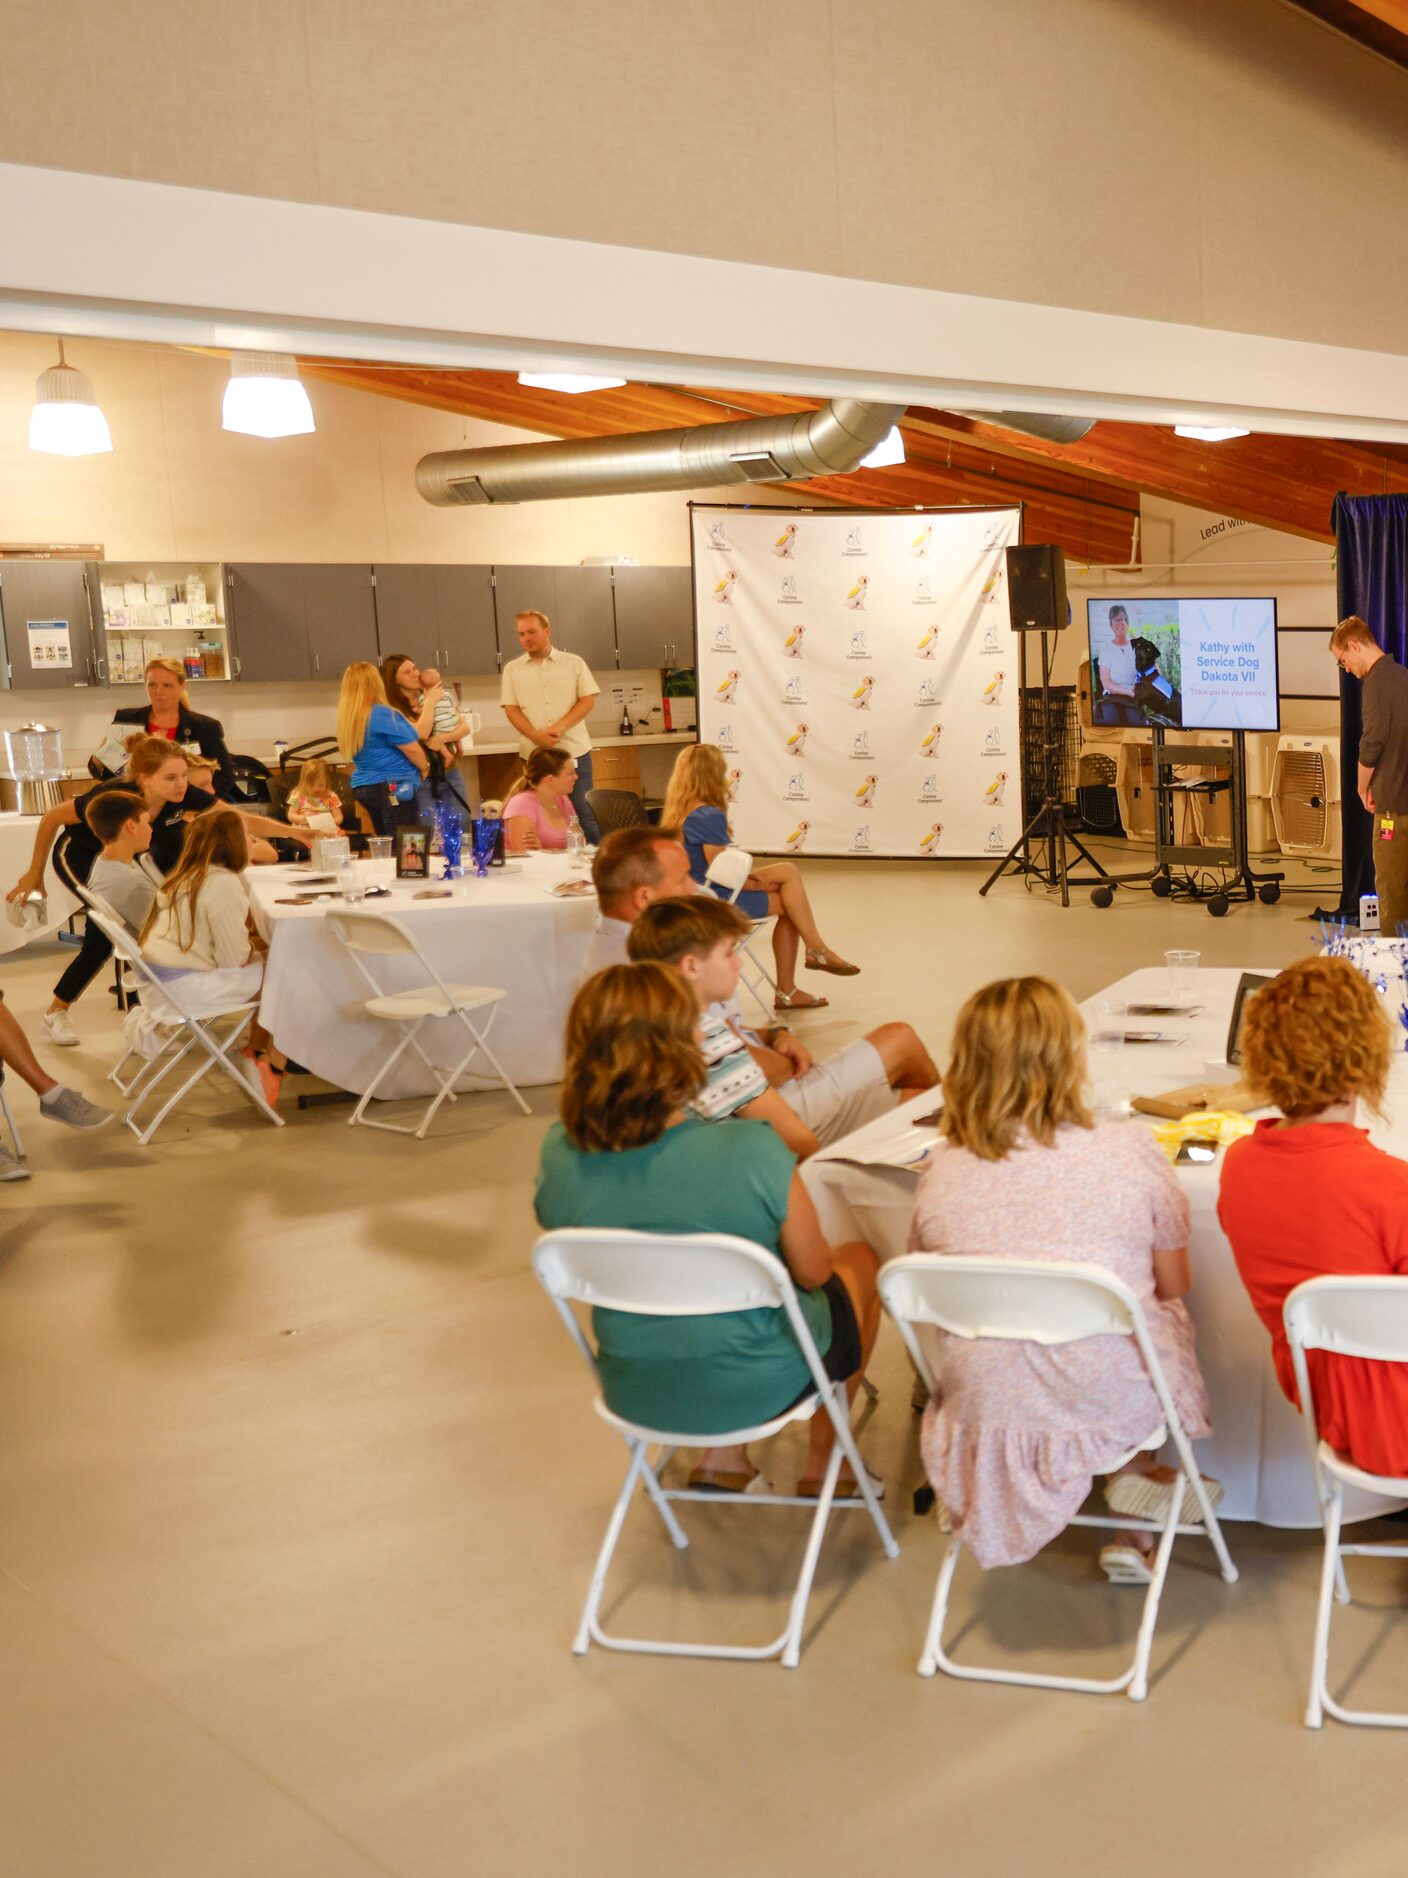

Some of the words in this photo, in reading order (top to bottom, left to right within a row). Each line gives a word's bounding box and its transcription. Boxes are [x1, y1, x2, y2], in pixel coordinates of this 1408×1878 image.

[1200, 520, 1226, 540] Lead
[1200, 642, 1230, 654] Kathy
[1232, 642, 1255, 652] with
[1197, 656, 1234, 666] Service
[1238, 657, 1259, 669] Dog
[1201, 671, 1238, 681] Dakota
[1241, 672, 1255, 682] VII
